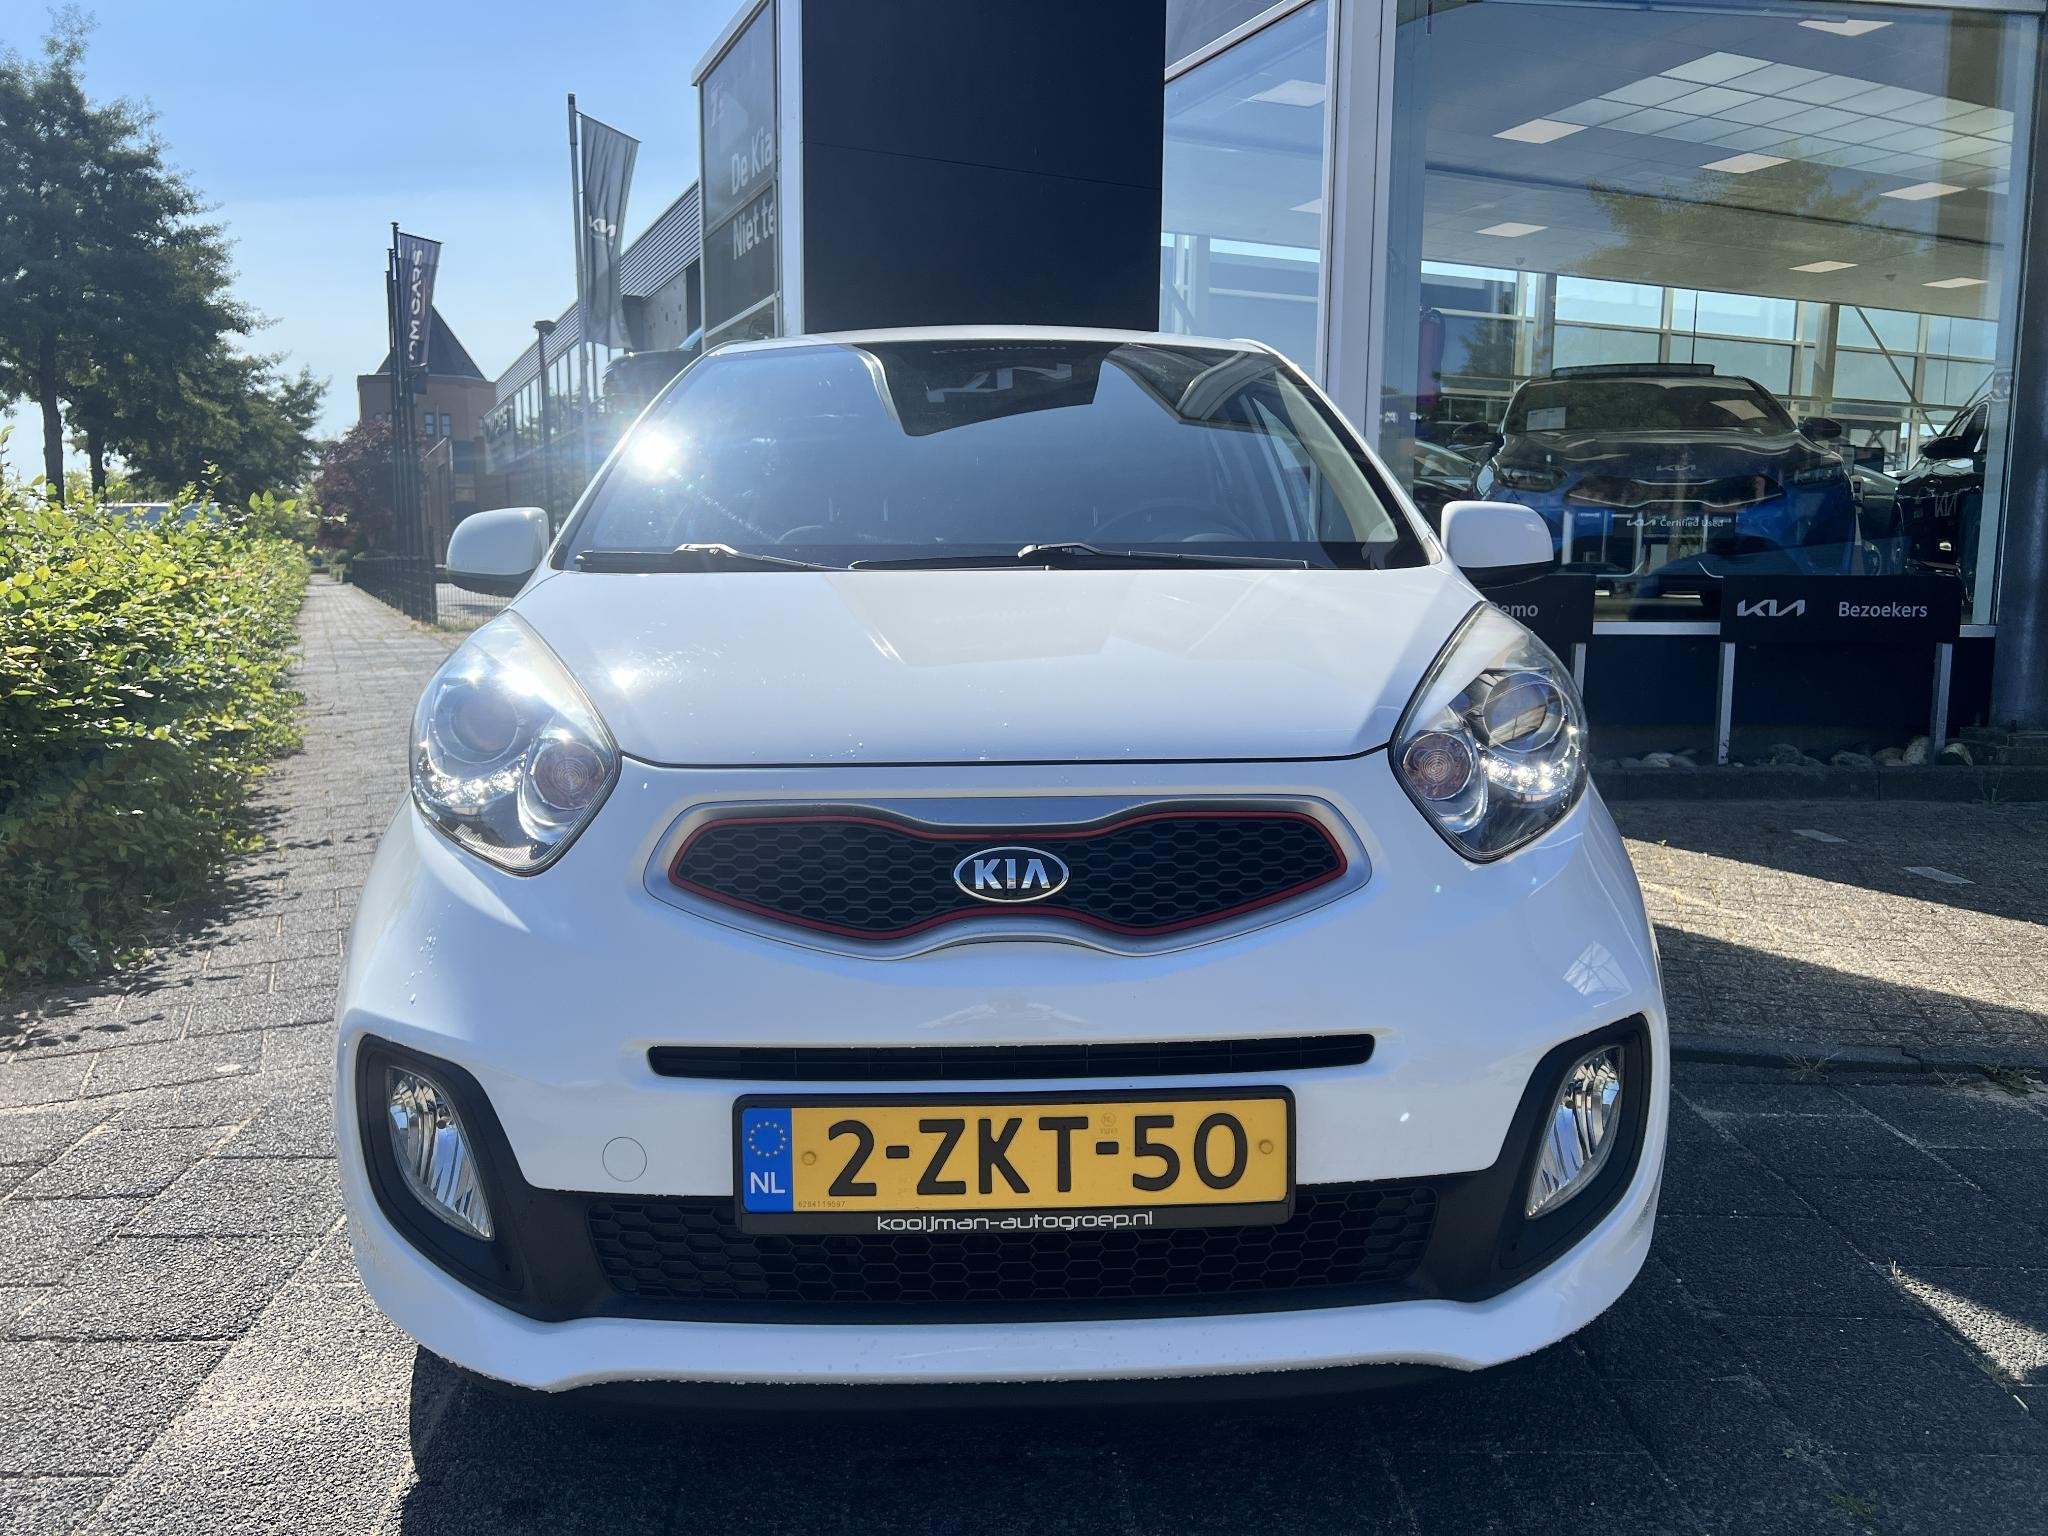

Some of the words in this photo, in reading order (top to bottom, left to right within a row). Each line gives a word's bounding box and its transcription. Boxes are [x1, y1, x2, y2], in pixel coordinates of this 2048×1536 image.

[731, 153, 748, 196] De
[751, 126, 773, 178] Kia
[733, 209, 760, 260] Niet
[1490, 601, 1539, 617] emo
[1838, 601, 1928, 617] Bezoekers
[973, 858, 1051, 890] KIA
[827, 1112, 1248, 1197] 2-ZKT-50
[750, 1171, 786, 1194] NL
[877, 1211, 1154, 1233] kooijman-autogroep.nl
